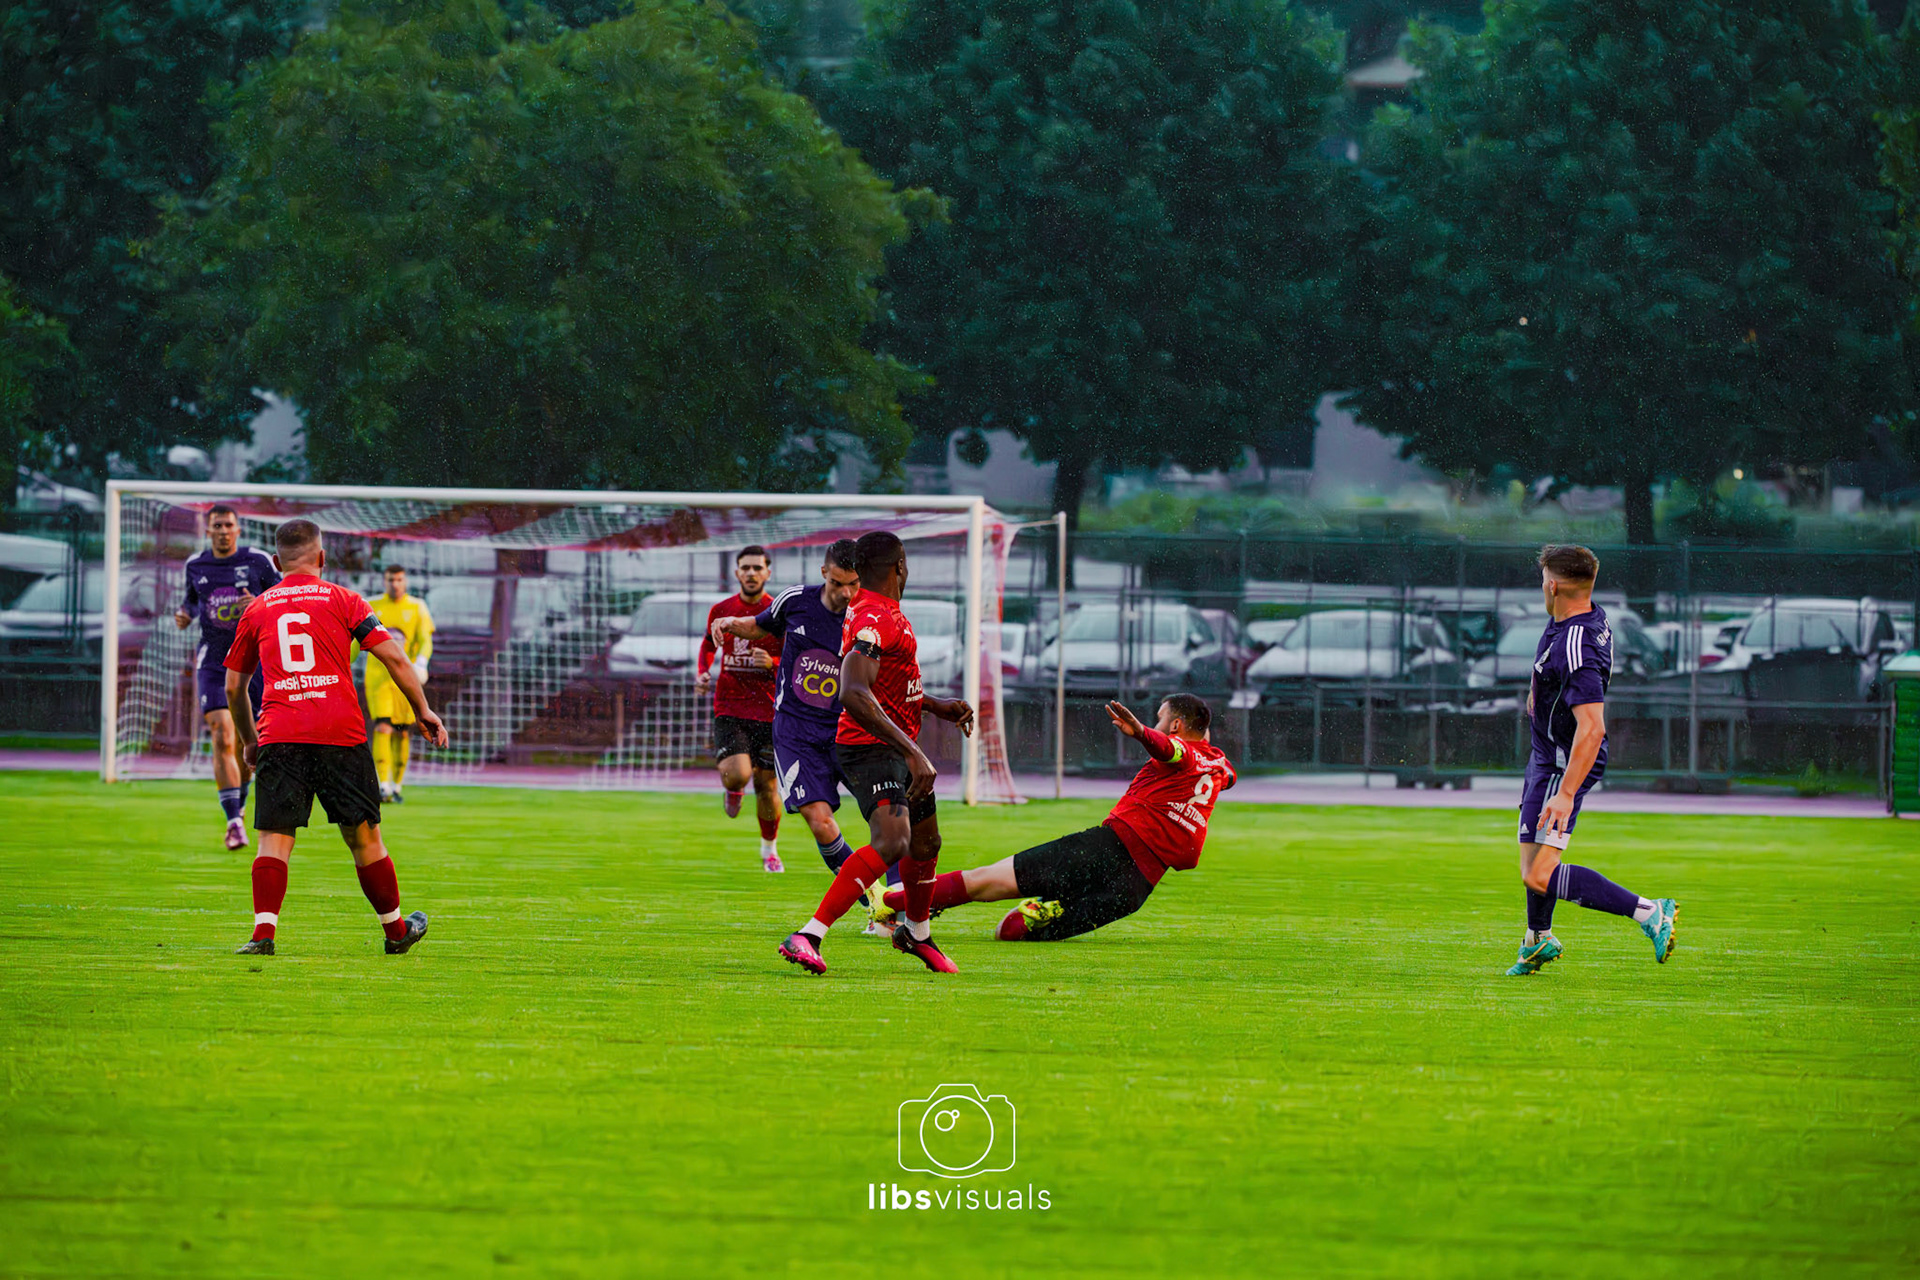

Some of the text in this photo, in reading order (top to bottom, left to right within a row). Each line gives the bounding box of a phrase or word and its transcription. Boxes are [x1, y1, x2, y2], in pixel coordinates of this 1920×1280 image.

[277, 612, 316, 673] 6
[800, 656, 840, 675] Sylvain
[300, 675, 339, 688] STORES
[795, 673, 803, 685] &
[795, 785, 805, 800] 16
